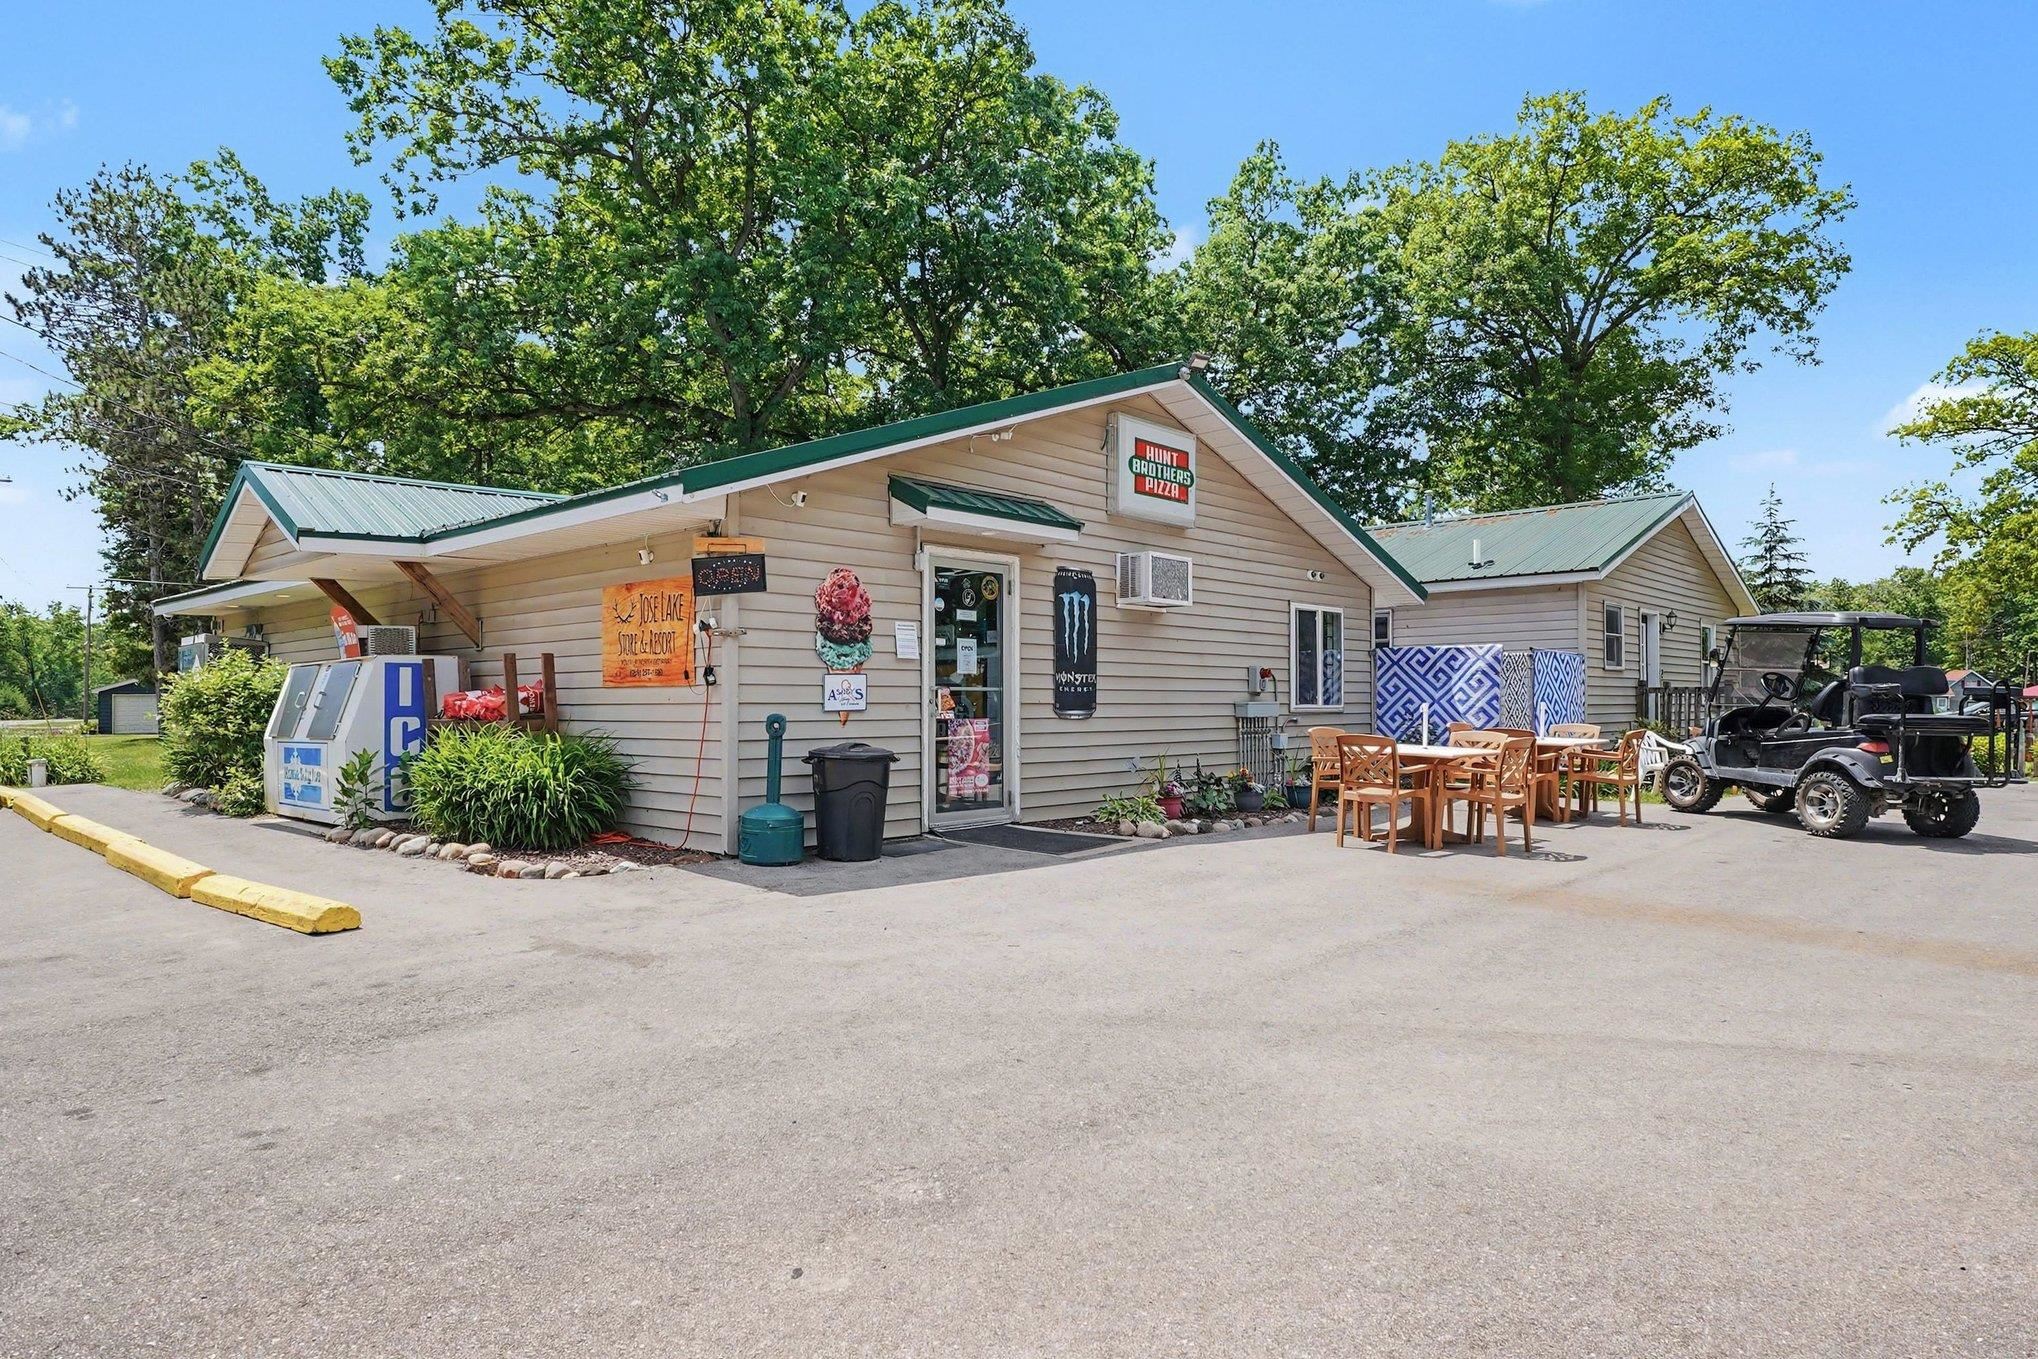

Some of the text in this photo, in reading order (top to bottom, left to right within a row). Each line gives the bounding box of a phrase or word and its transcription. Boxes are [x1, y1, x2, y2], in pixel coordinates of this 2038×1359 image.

[1146, 445, 1178, 467] HUNT
[1132, 458, 1191, 485] BROTHERS
[1145, 477, 1179, 498] PIZZA
[698, 564, 759, 585] OPEN
[639, 590, 684, 626] JOSE LAKE
[618, 629, 676, 656] STORE & RESORT
[1055, 670, 1097, 686] MONSTER
